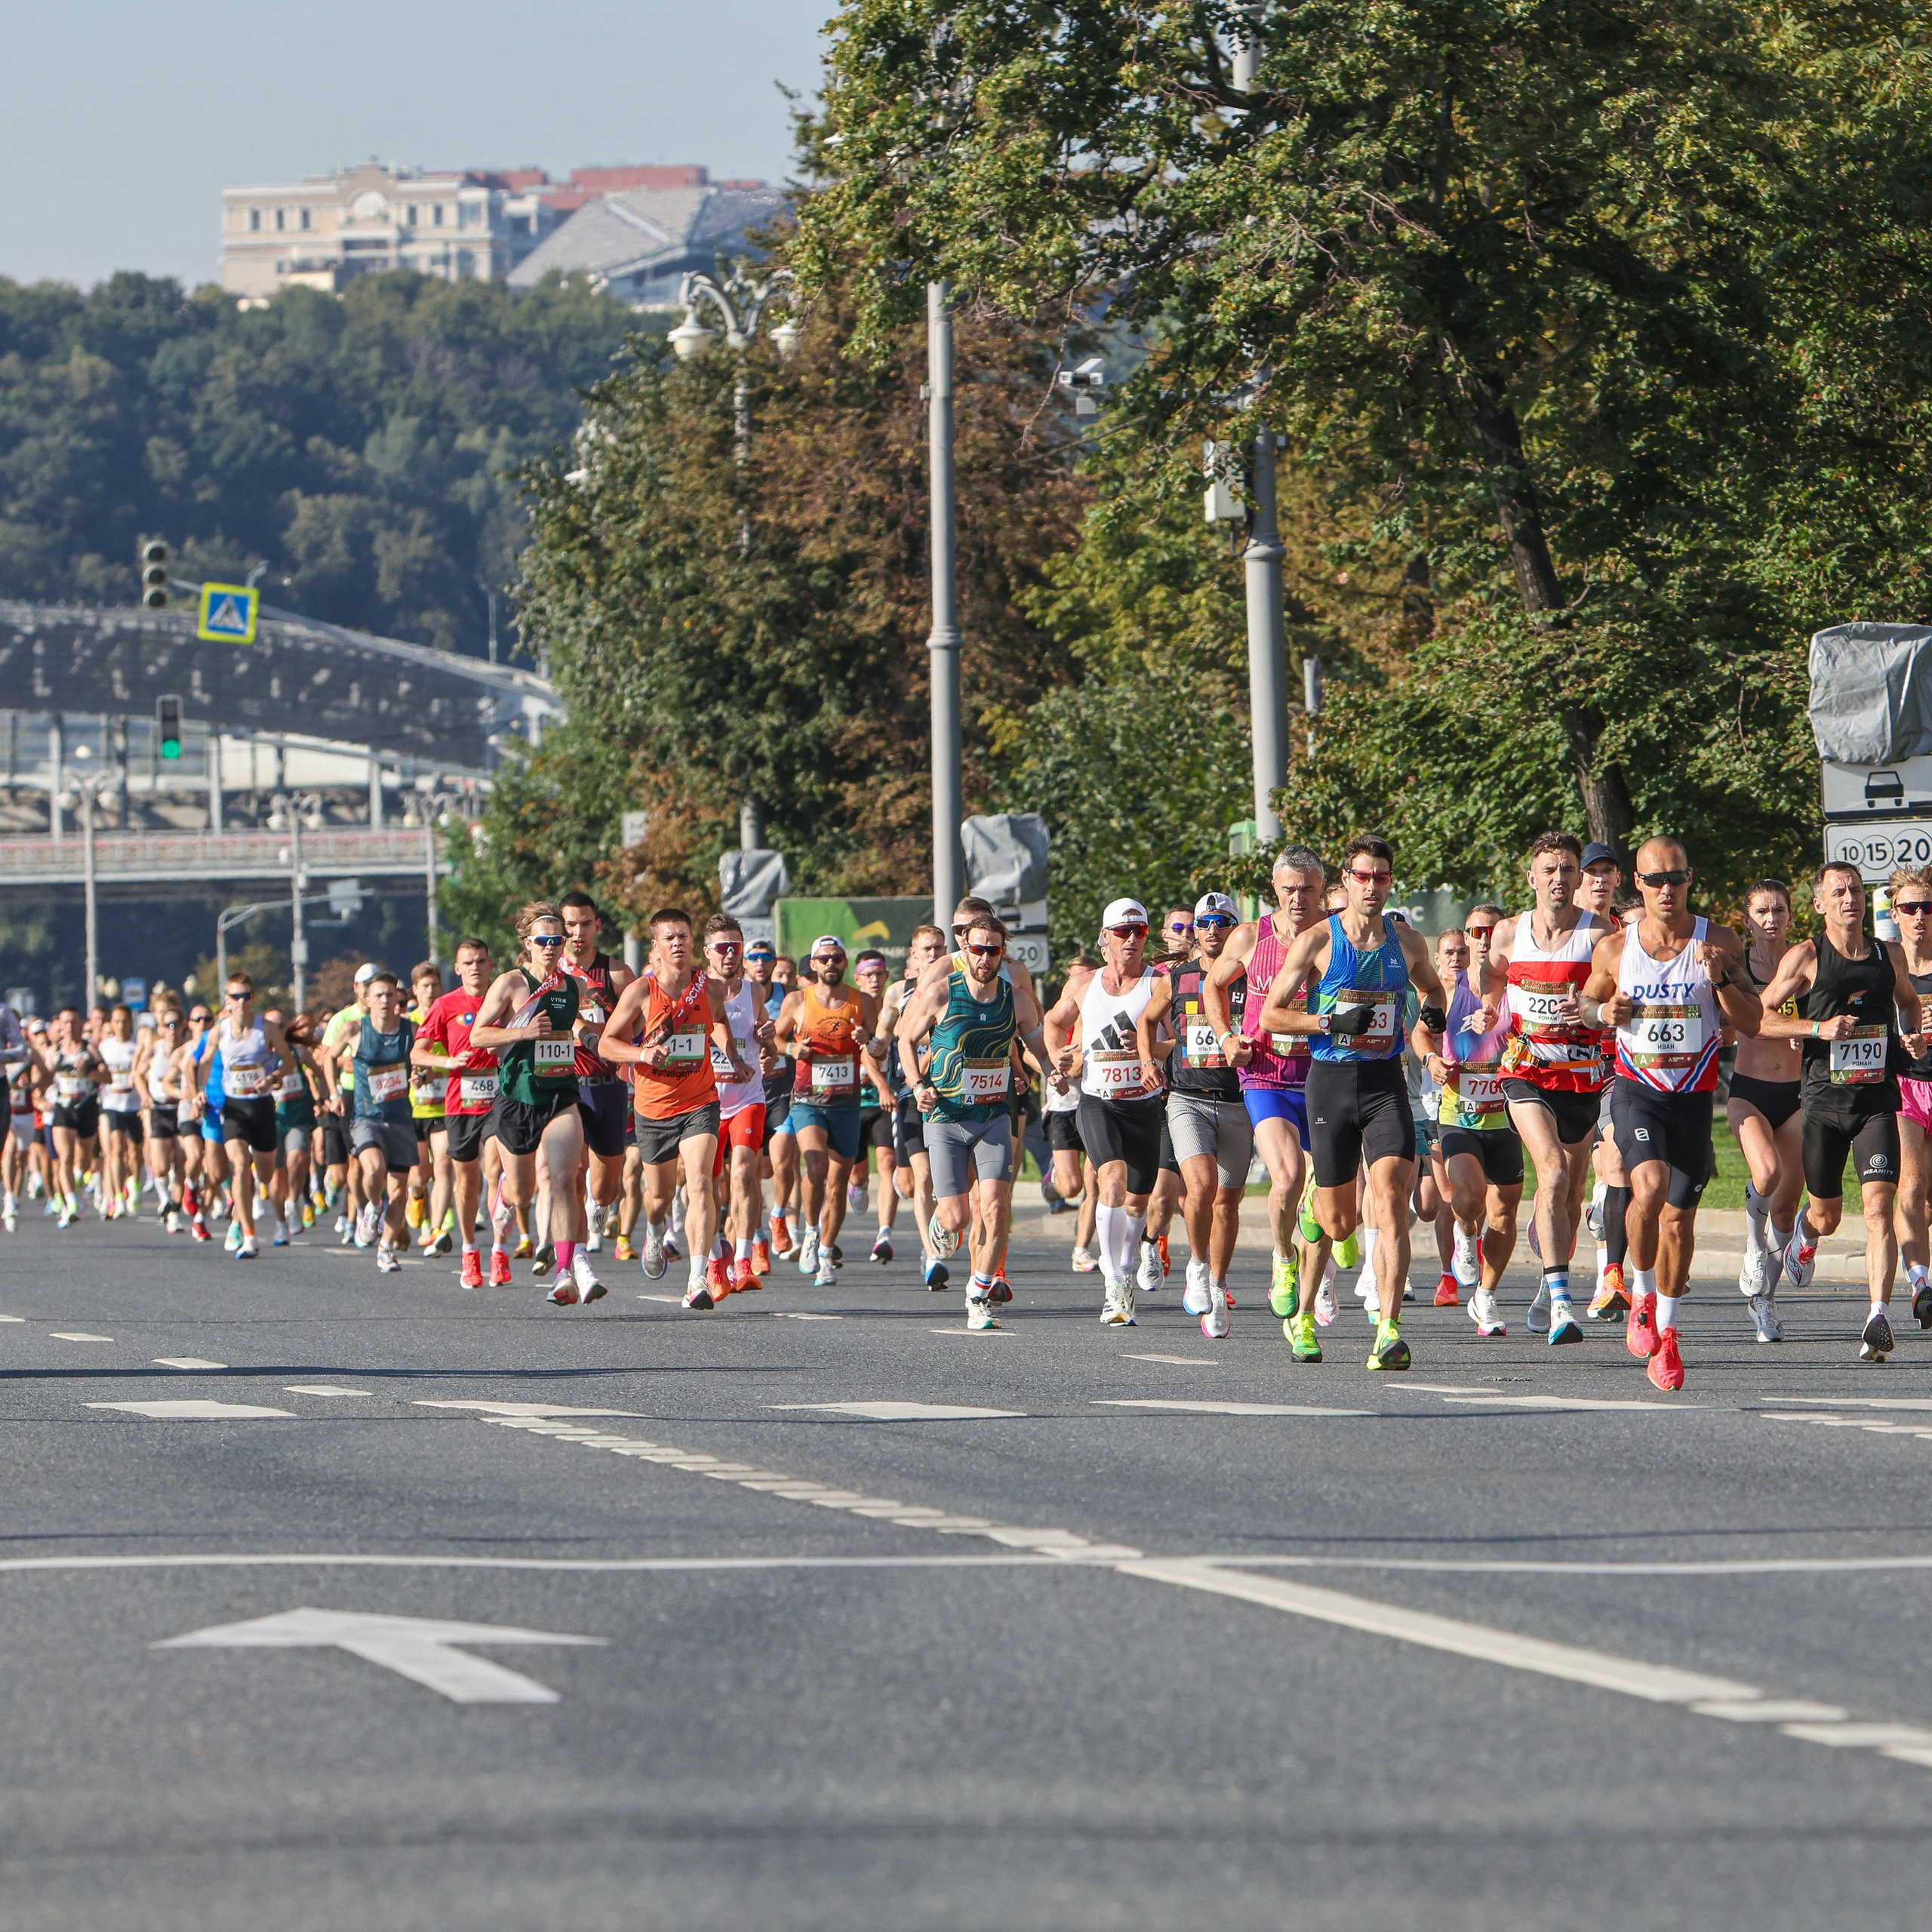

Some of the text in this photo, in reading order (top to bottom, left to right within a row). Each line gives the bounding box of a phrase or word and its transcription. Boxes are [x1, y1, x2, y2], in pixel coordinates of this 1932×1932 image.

[1841, 838, 1930, 862] 10 15 20
[1017, 946, 1037, 961] 20
[1632, 983, 1696, 1000] DUSTY
[1647, 1024, 1684, 1042] 663
[539, 1044, 571, 1058] 110-1
[670, 1038, 692, 1052] 1-1
[1840, 1042, 1881, 1060] 7190
[819, 1066, 848, 1078] 7413
[1103, 1066, 1142, 1082] 7813
[471, 1079, 494, 1091] 468
[971, 1074, 1002, 1089] 7514
[1863, 1168, 1894, 1177] INSANITY
